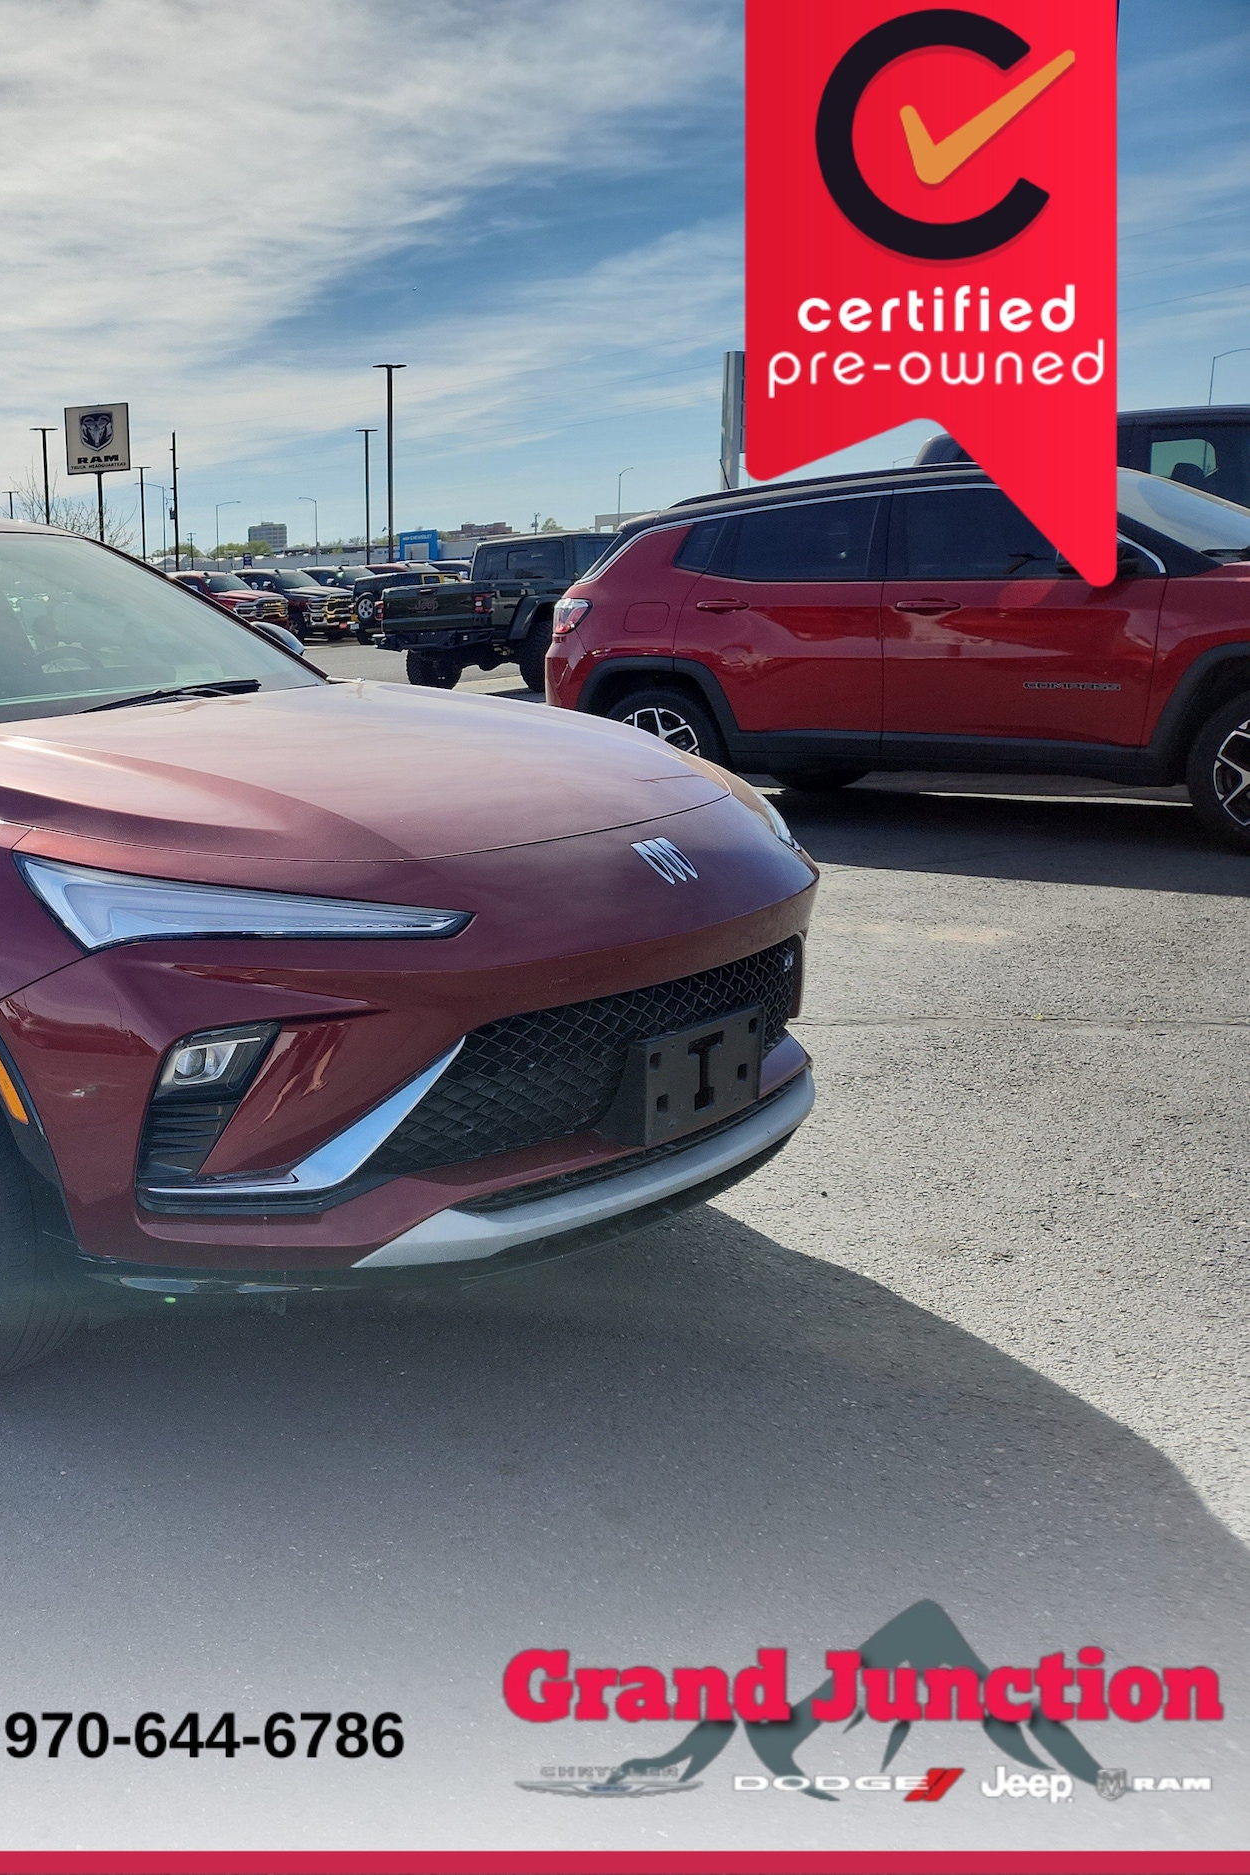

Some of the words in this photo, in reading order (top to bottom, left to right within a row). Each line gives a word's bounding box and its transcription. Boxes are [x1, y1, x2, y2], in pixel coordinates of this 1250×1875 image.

[77, 454, 119, 464] RAM
[414, 598, 440, 612] Jeep
[1023, 681, 1121, 691] COMPASS
